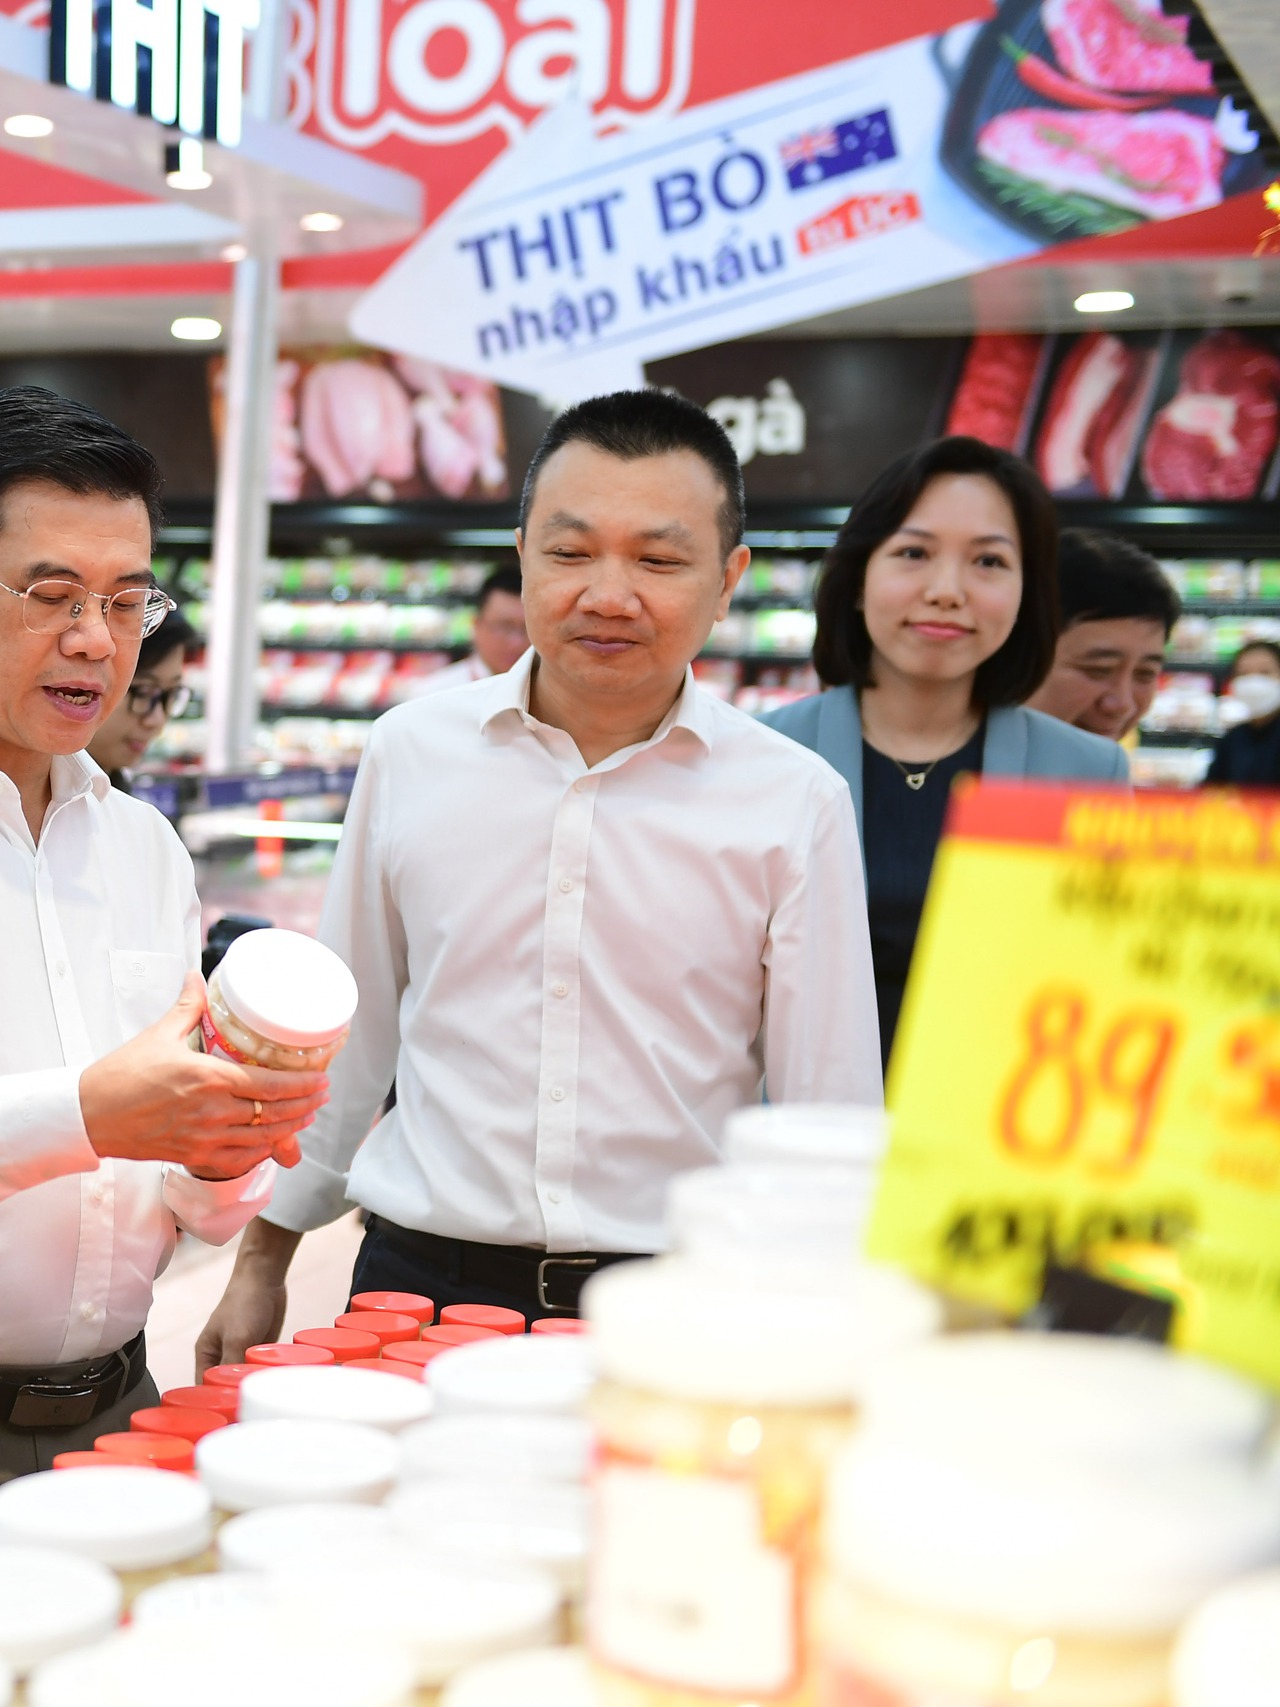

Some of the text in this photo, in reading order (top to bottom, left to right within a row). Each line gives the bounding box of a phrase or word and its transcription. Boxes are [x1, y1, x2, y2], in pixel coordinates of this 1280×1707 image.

[458, 131, 768, 293] THỊT BÒ
[476, 286, 618, 360] nhập
[704, 377, 806, 466] gà
